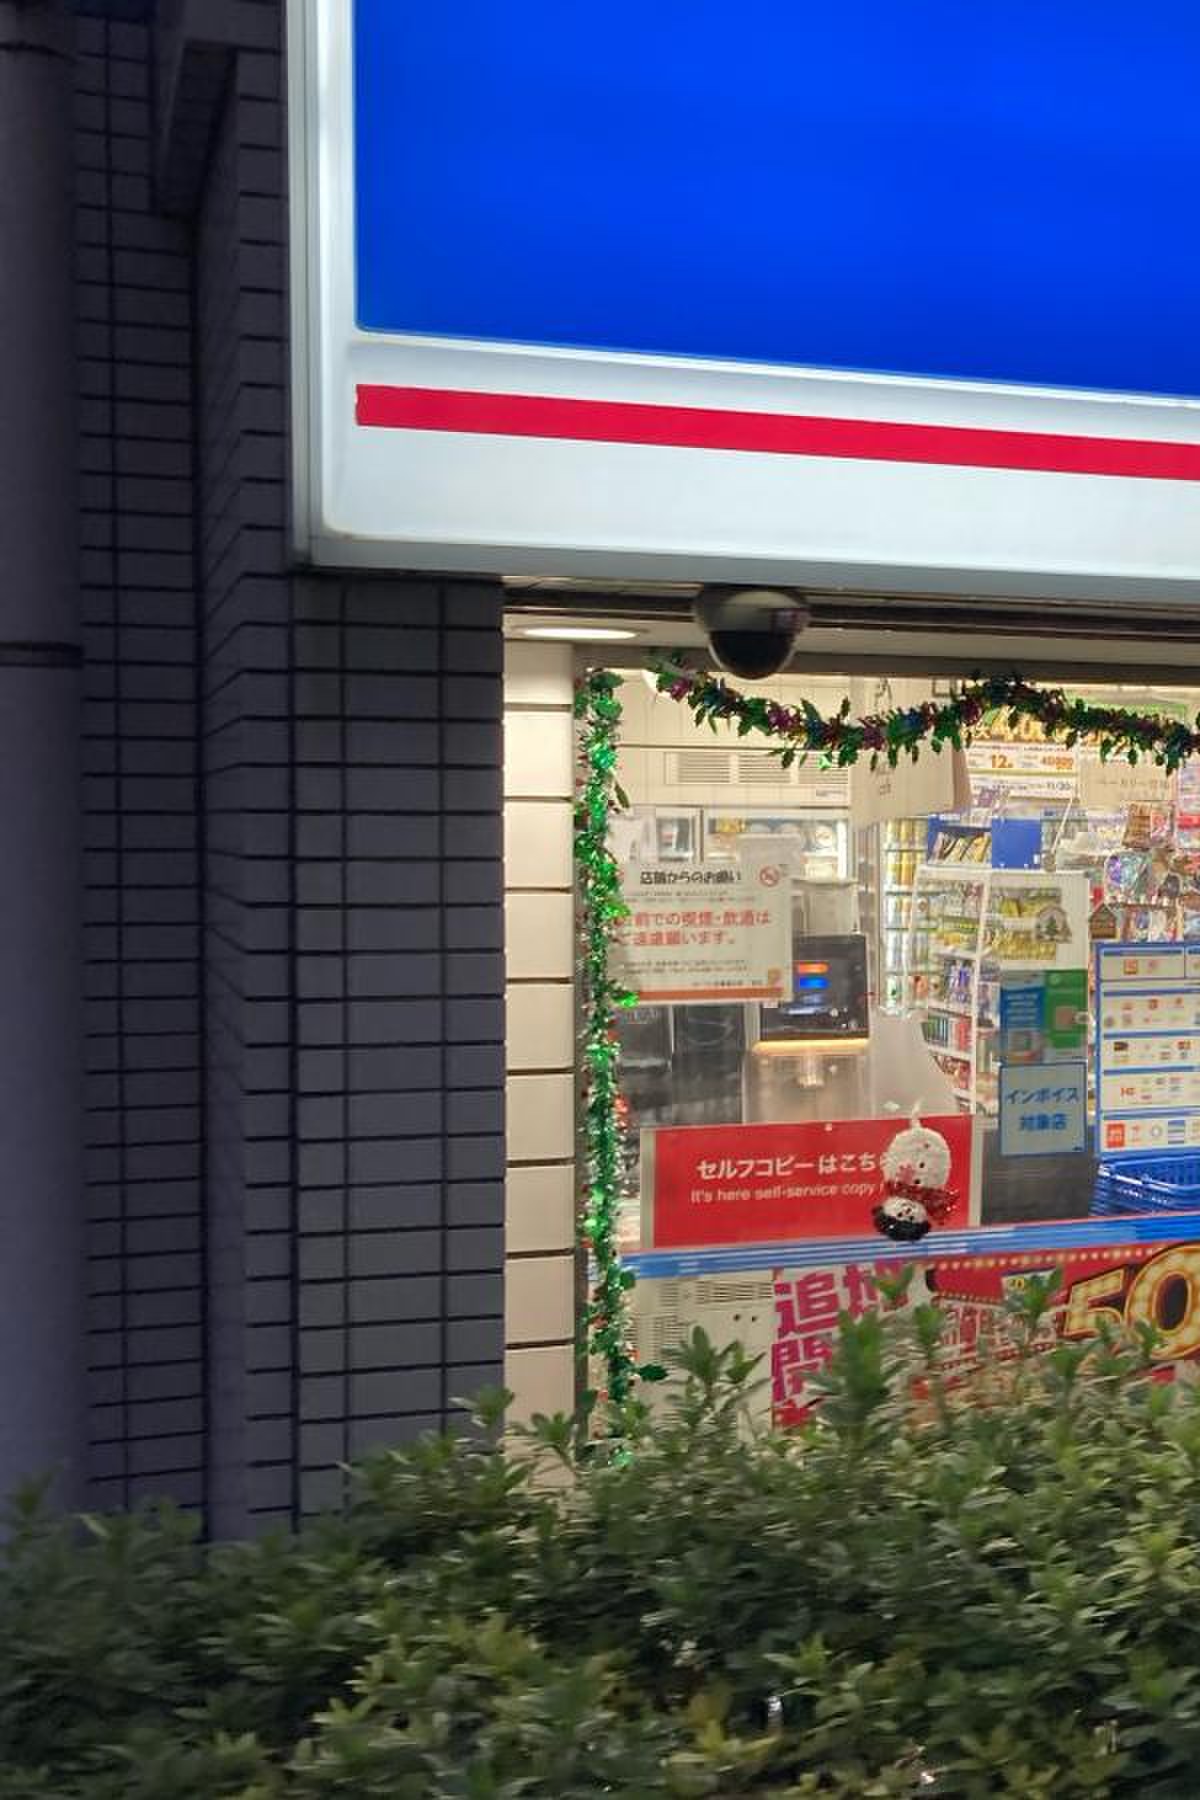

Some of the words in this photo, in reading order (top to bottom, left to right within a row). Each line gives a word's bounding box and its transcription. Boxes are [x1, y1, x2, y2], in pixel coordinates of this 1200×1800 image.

[1005, 1087, 1078, 1106] インボイス
[696, 1152, 884, 1180] セルフコピーはこち
[717, 1187, 750, 1202] here
